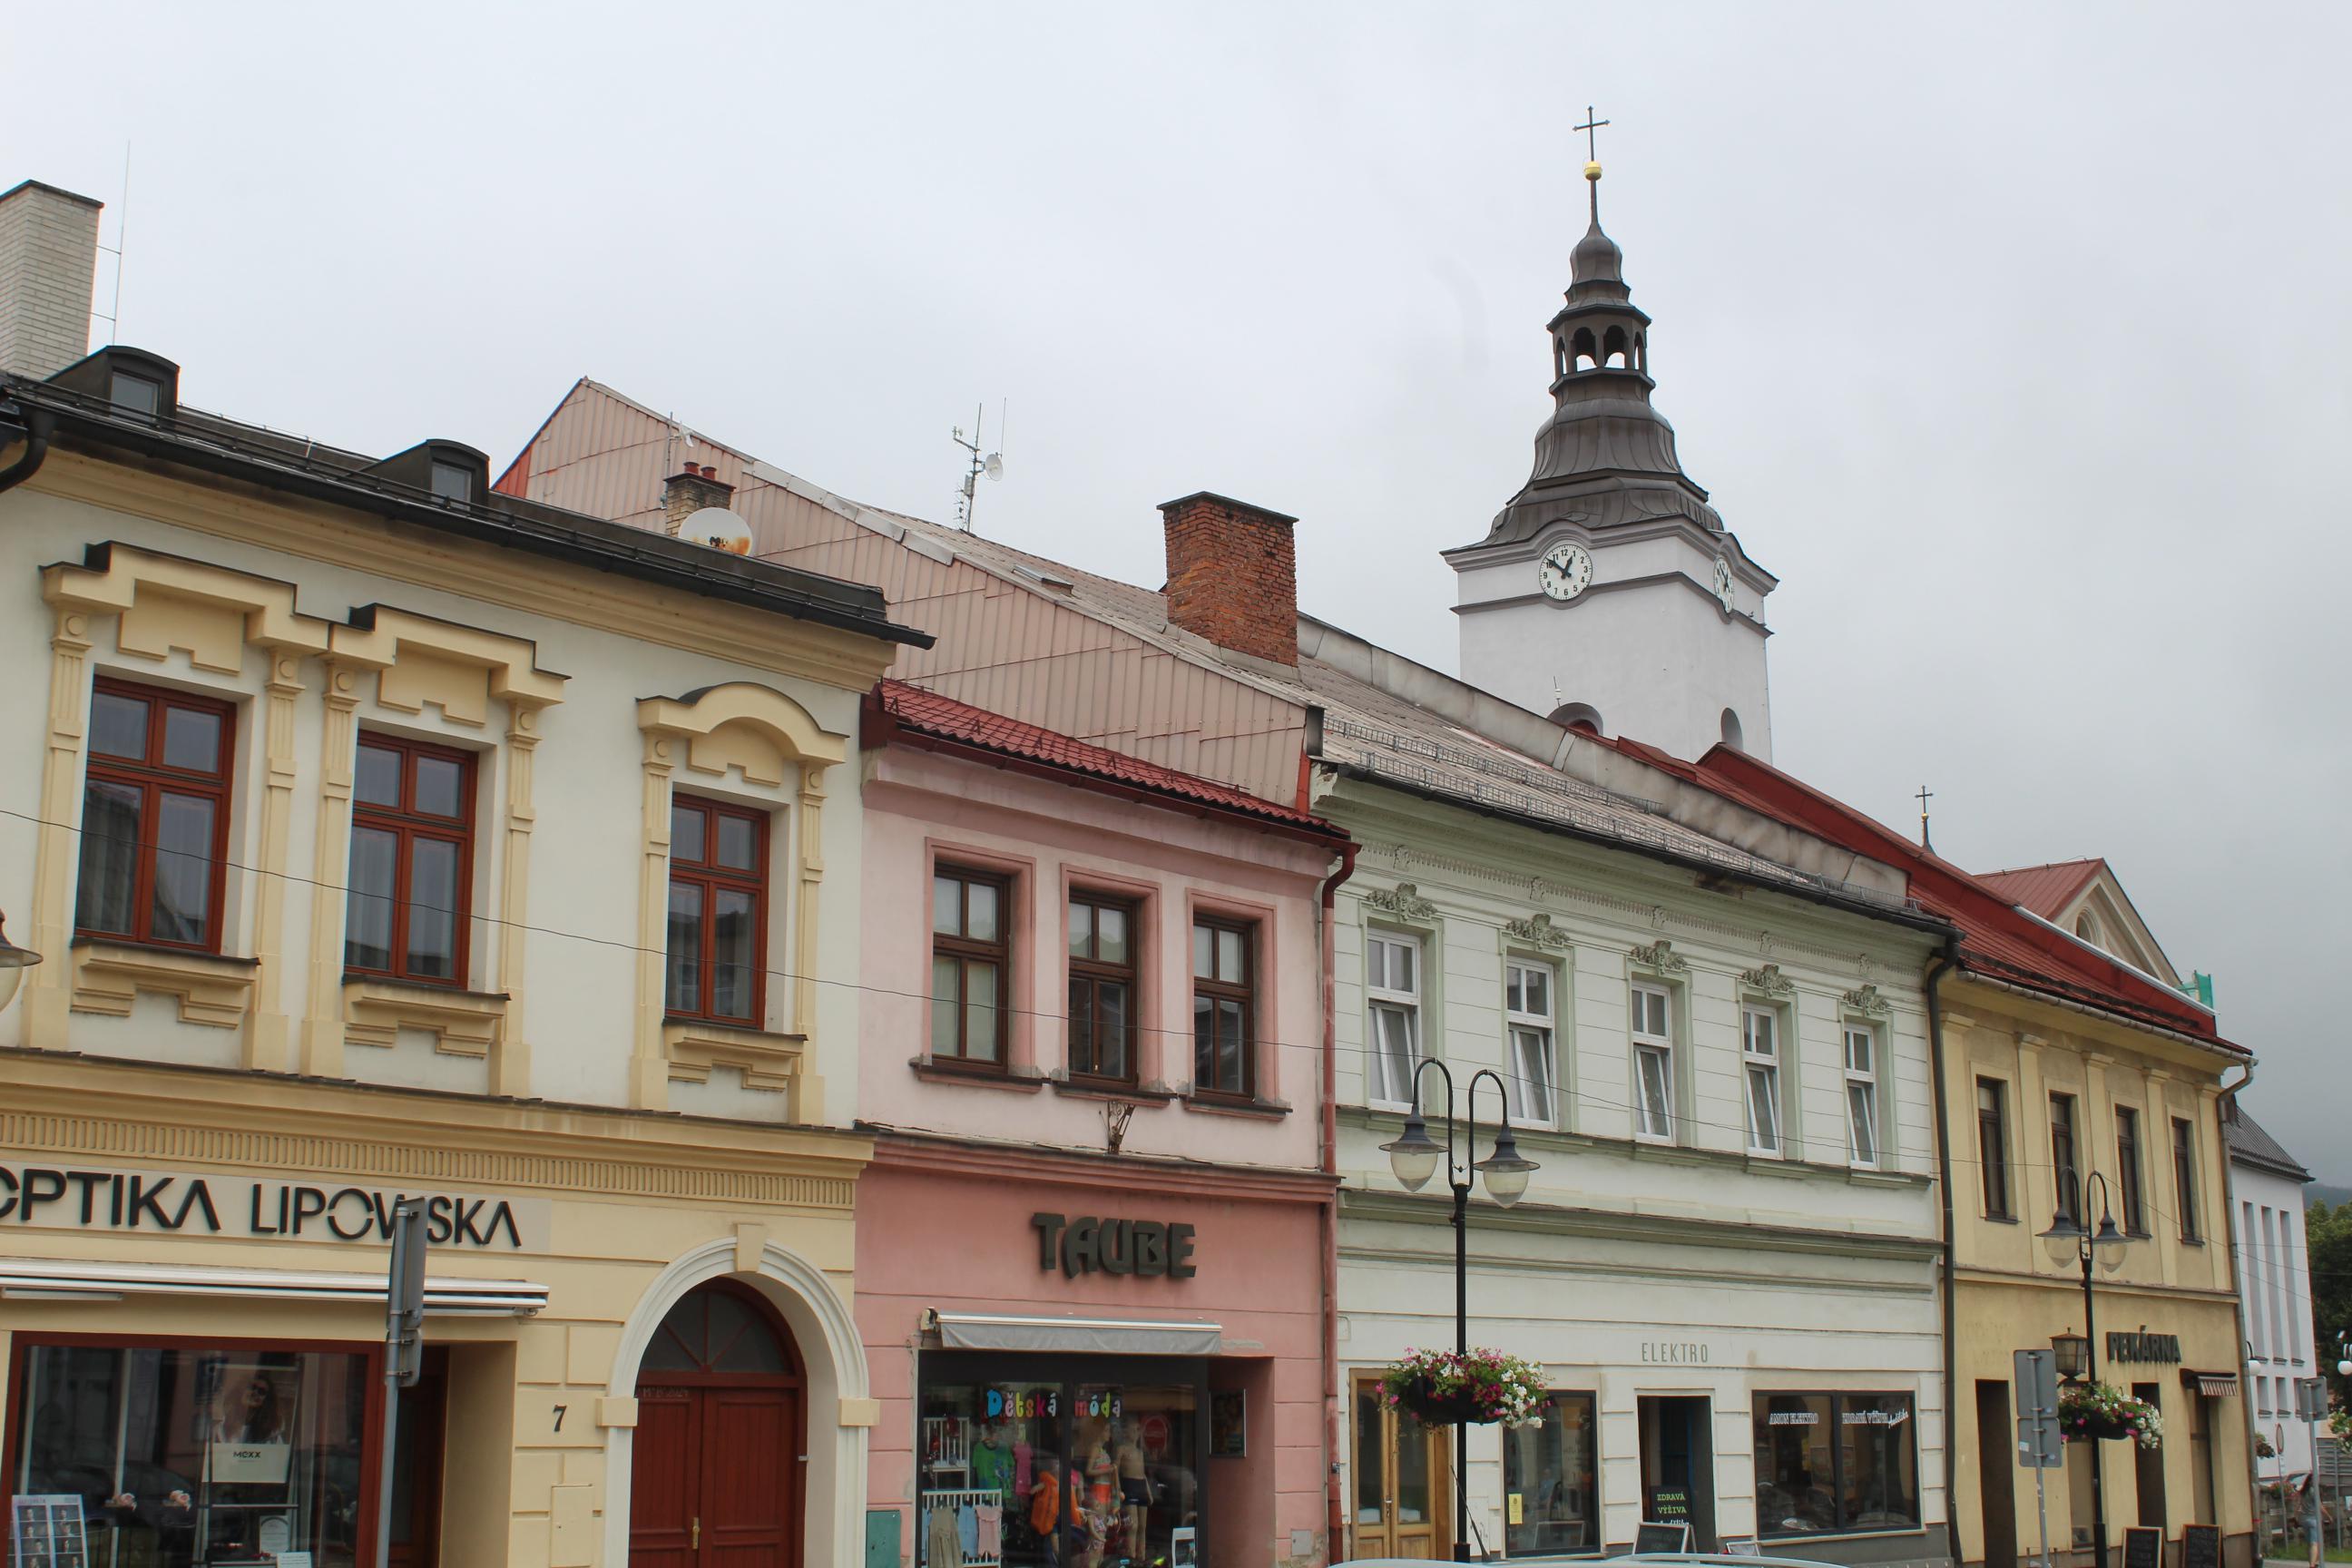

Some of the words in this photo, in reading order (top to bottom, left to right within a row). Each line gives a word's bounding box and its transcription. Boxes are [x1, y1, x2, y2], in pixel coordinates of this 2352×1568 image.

[1031, 1212, 1197, 1279] TAUBE
[1642, 1343, 1708, 1363] ELEKTRO
[2106, 1325, 2181, 1363] PEKÁRNA
[987, 1389, 1056, 1417] Dětská
[1074, 1392, 1121, 1417] móda
[554, 1405, 567, 1432] 7
